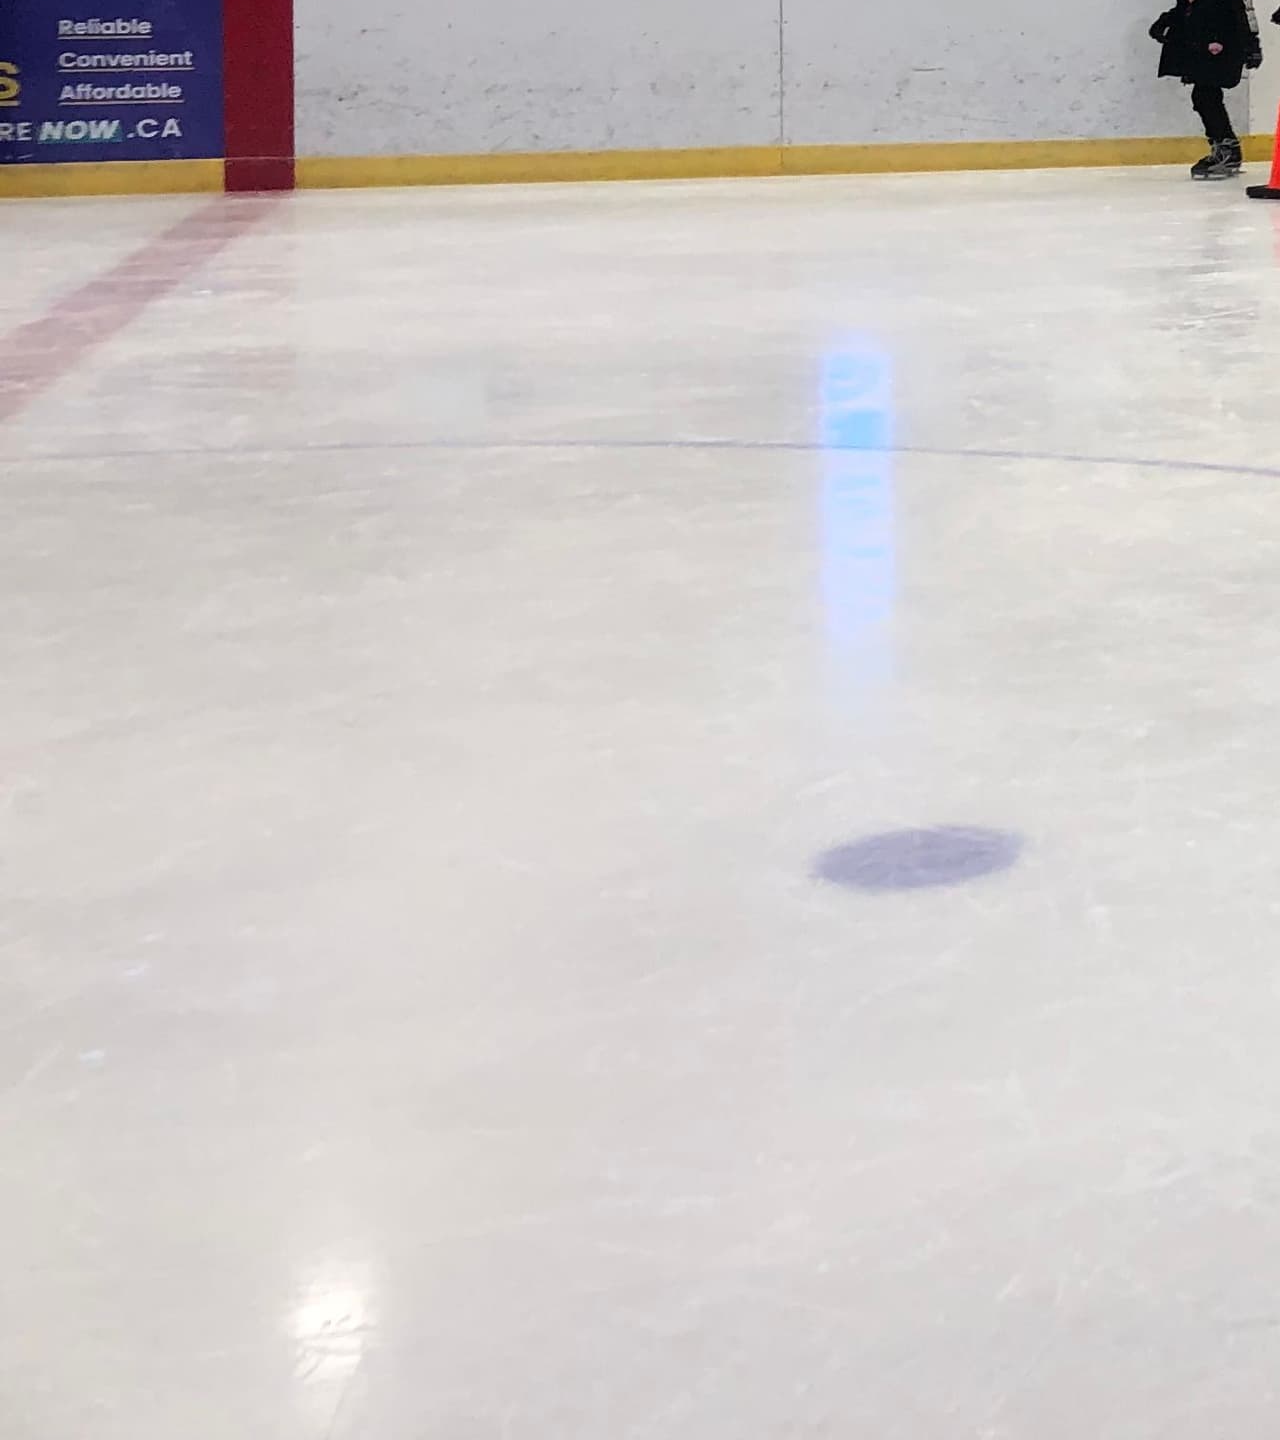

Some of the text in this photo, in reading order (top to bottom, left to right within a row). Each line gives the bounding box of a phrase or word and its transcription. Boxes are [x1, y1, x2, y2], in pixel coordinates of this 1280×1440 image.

[58, 18, 153, 36] Reliable
[58, 50, 194, 69] Convenient
[59, 83, 183, 101] Affordable
[38, 119, 121, 141] NOW
